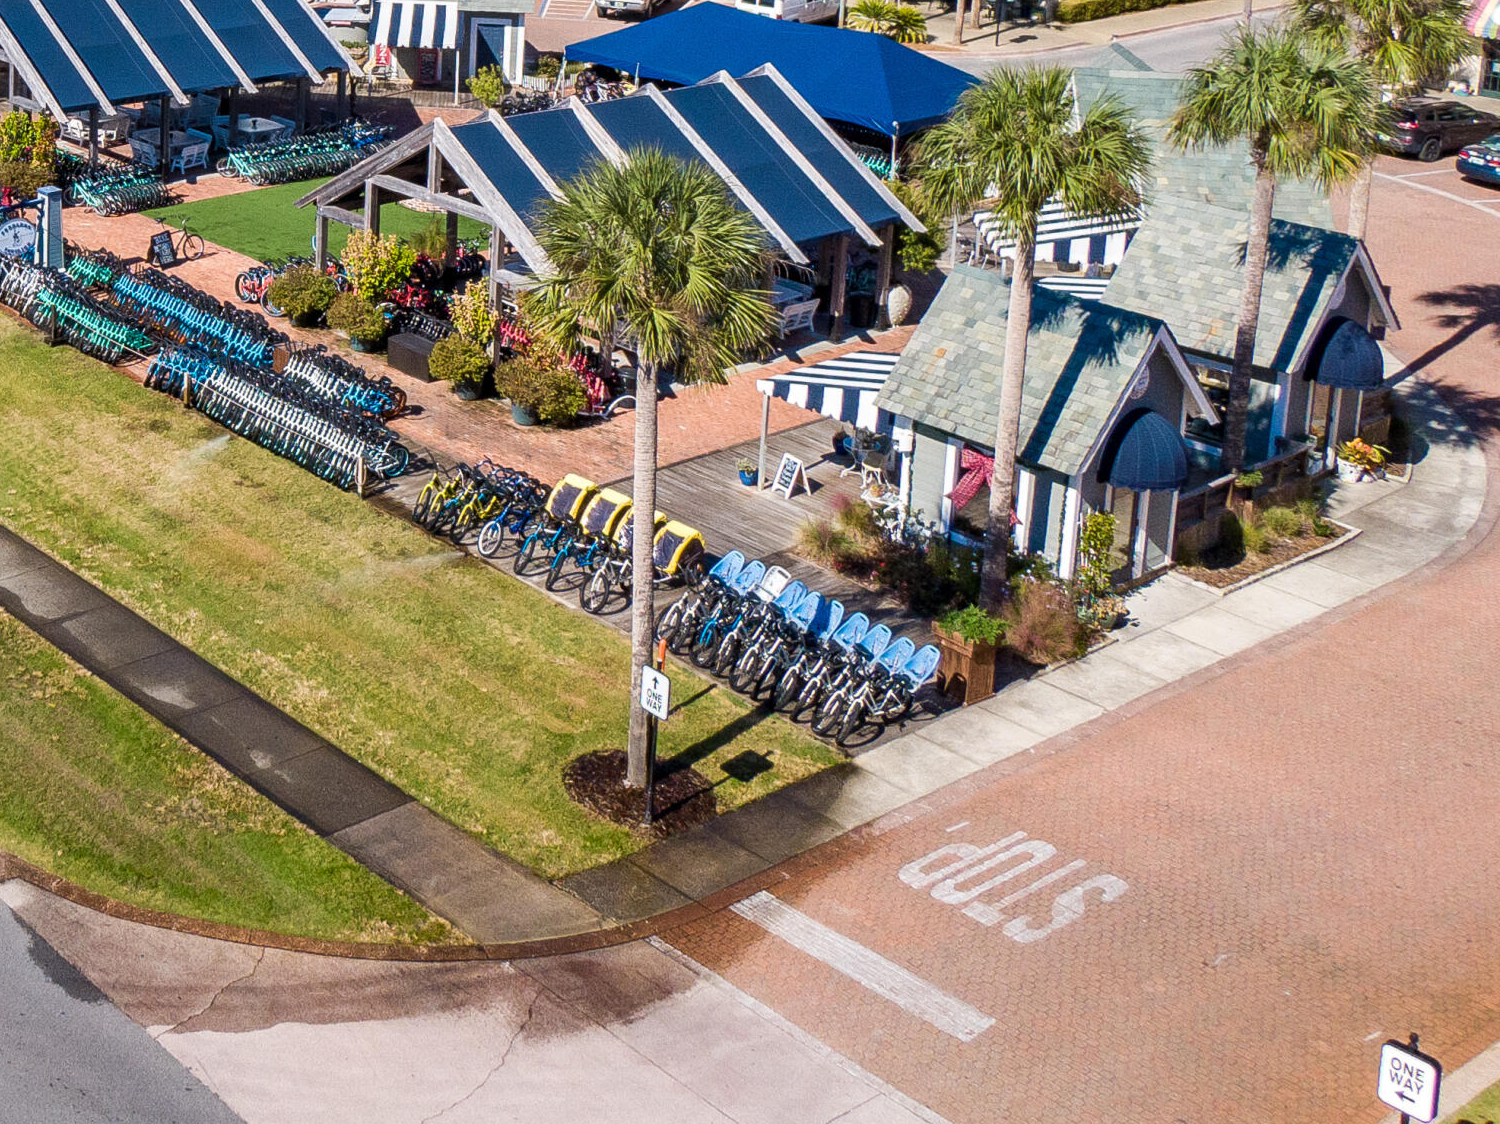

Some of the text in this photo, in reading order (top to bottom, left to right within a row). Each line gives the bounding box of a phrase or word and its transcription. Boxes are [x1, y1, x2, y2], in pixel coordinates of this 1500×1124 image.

[646, 697, 662, 712] WAY
[647, 688, 662, 704] ONE
[898, 830, 1129, 943] STOP
[1390, 1069, 1424, 1094] WAY
[1391, 1057, 1425, 1083] ONE
